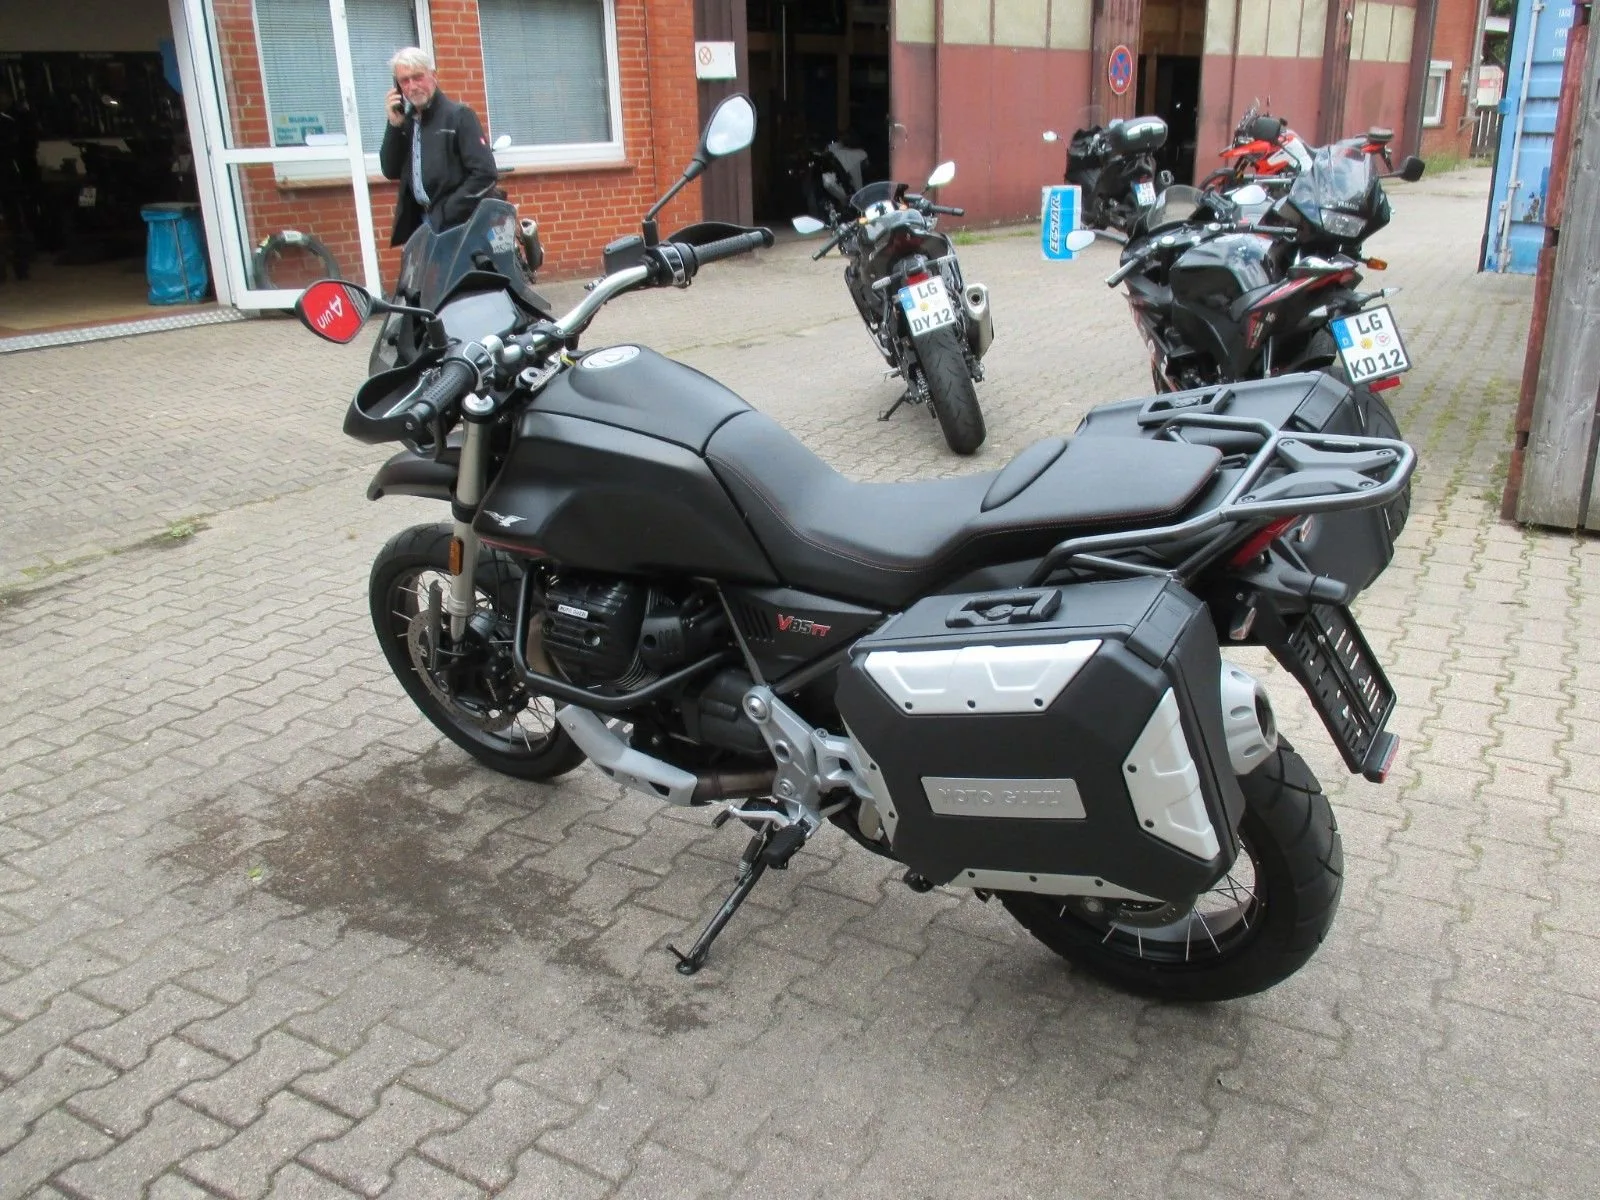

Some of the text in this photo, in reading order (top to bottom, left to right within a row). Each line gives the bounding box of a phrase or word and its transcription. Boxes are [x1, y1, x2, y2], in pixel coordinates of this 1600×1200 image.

[917, 282, 938, 299] LG
[912, 307, 952, 332] DY 12
[1355, 313, 1383, 335] LG
[1349, 348, 1404, 379] KD 12
[938, 788, 1062, 805] MOTO GUZZI
